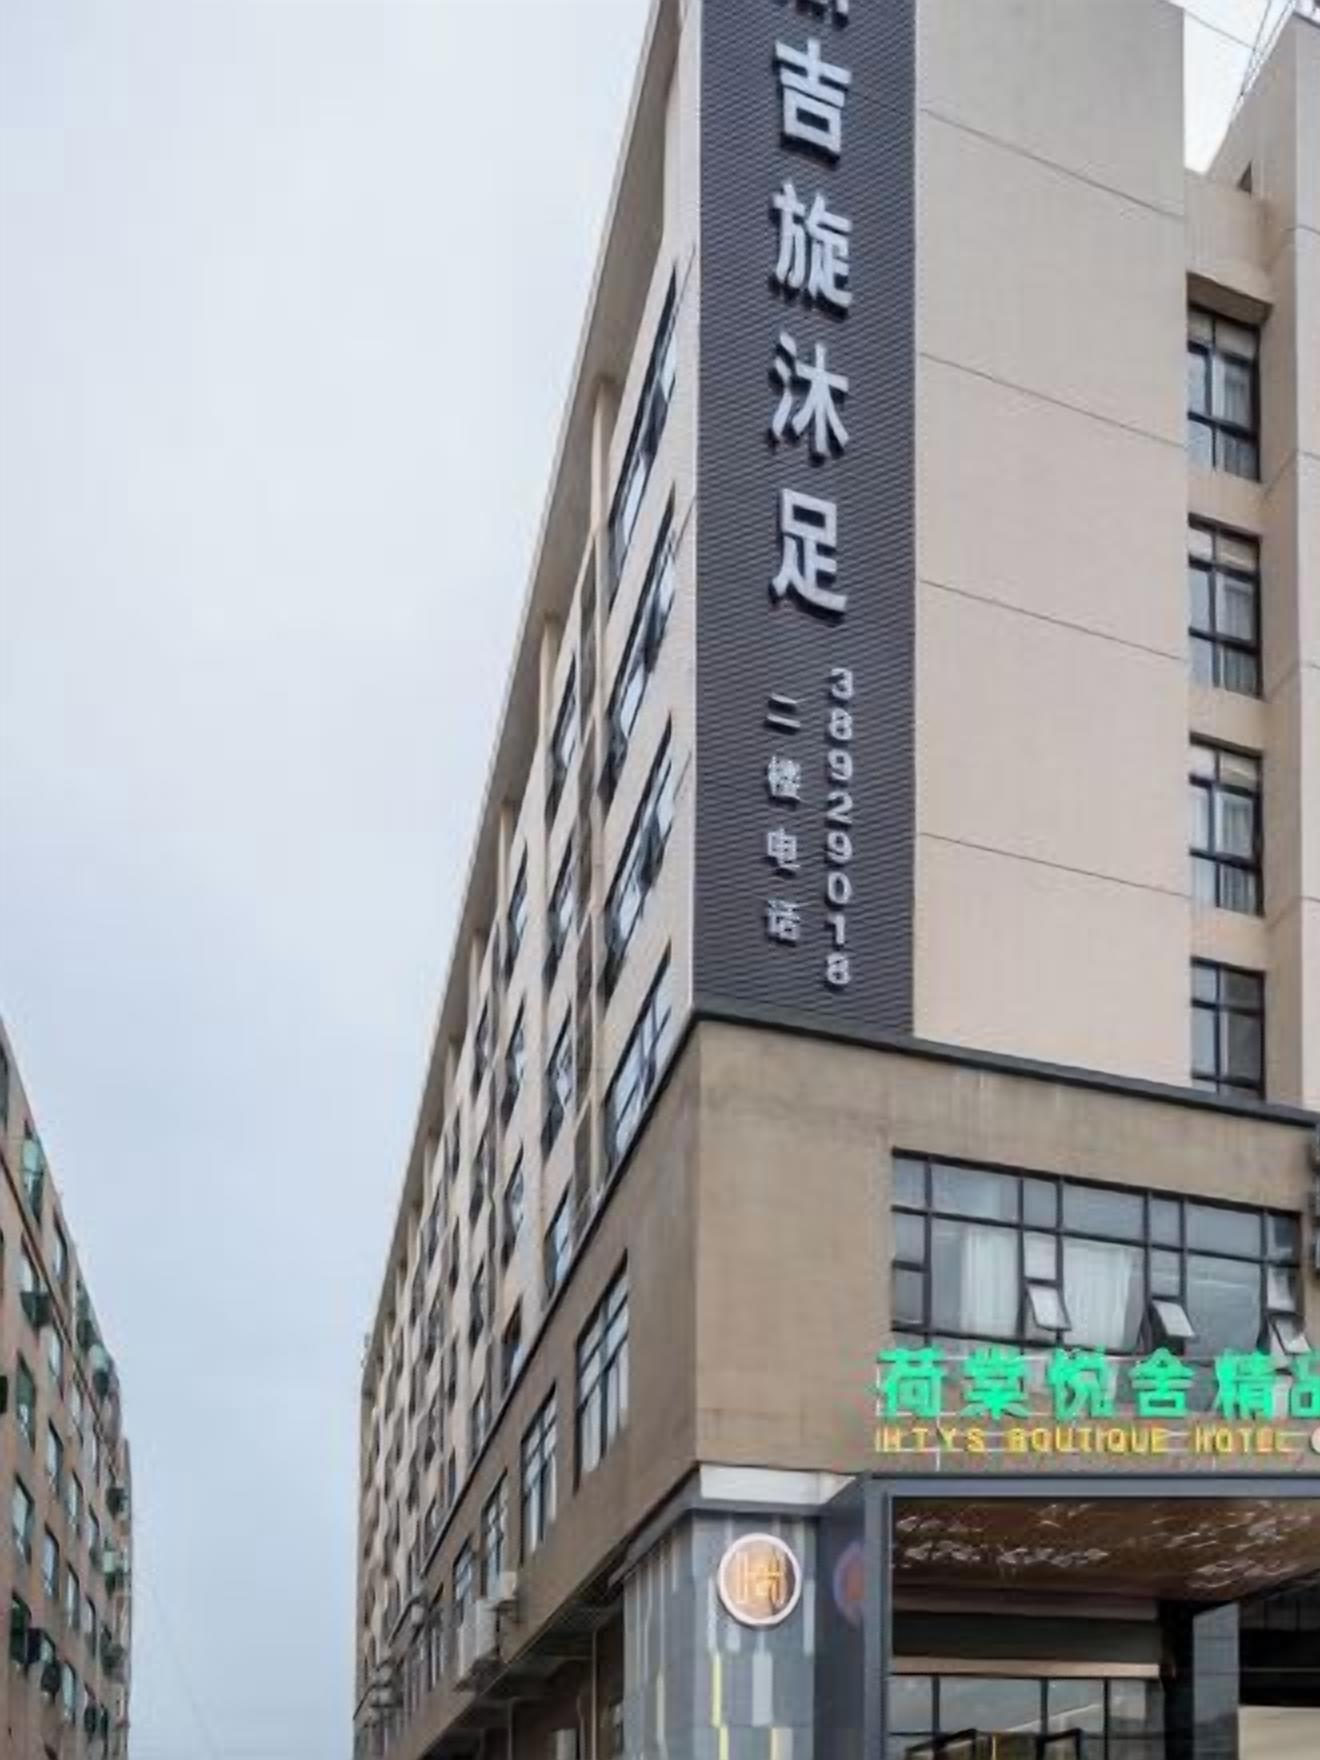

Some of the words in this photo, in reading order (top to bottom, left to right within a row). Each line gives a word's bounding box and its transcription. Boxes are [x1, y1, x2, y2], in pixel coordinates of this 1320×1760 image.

[772, 0, 852, 611] 吉旋沐足
[826, 667, 854, 986] 38929018
